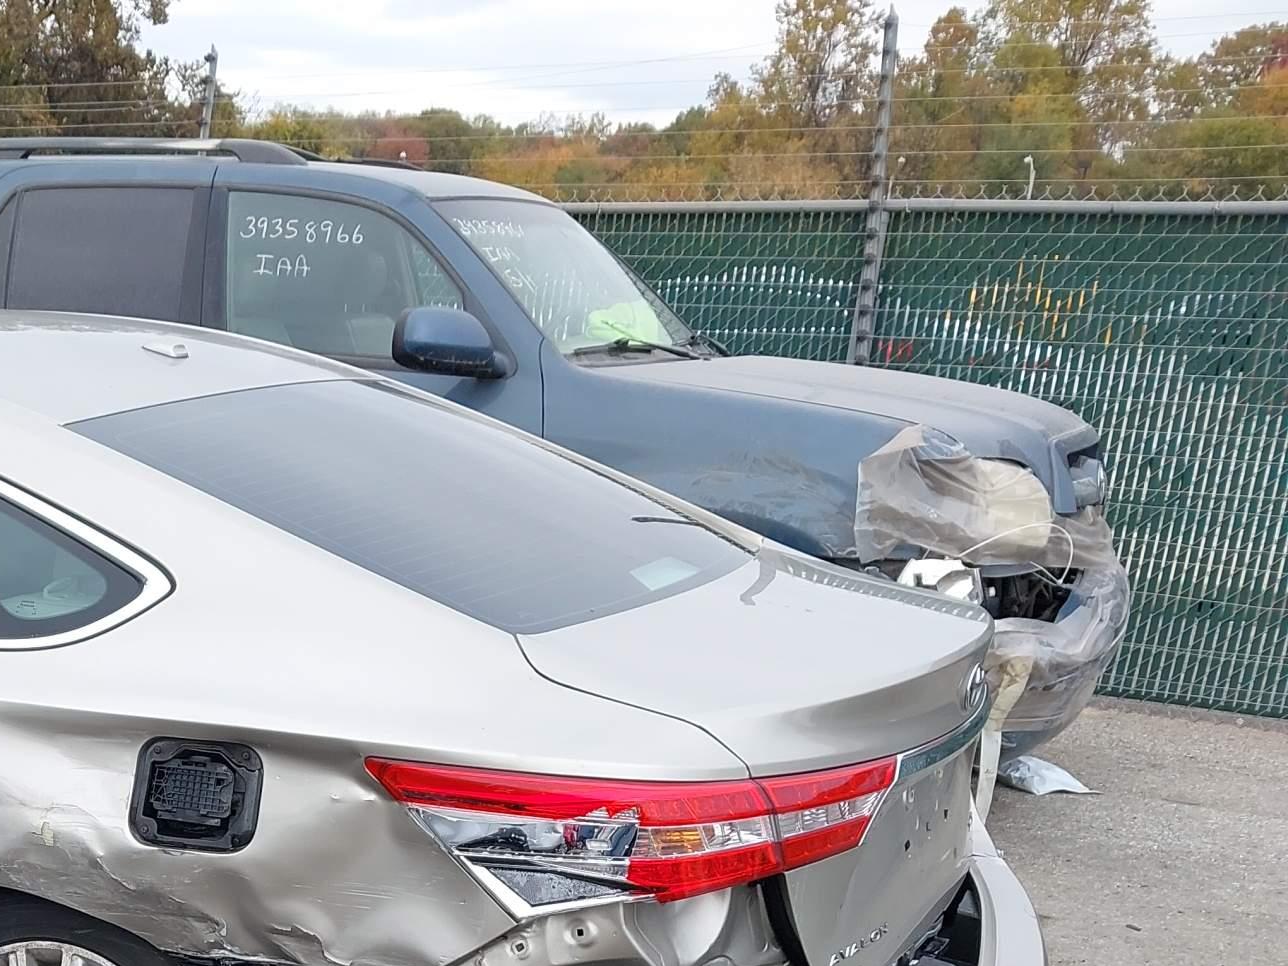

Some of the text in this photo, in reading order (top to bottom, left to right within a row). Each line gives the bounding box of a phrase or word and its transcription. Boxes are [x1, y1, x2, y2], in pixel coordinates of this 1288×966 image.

[240, 216, 364, 244] 39358966
[253, 254, 311, 277] IAA
[828, 922, 889, 966] AVALON
